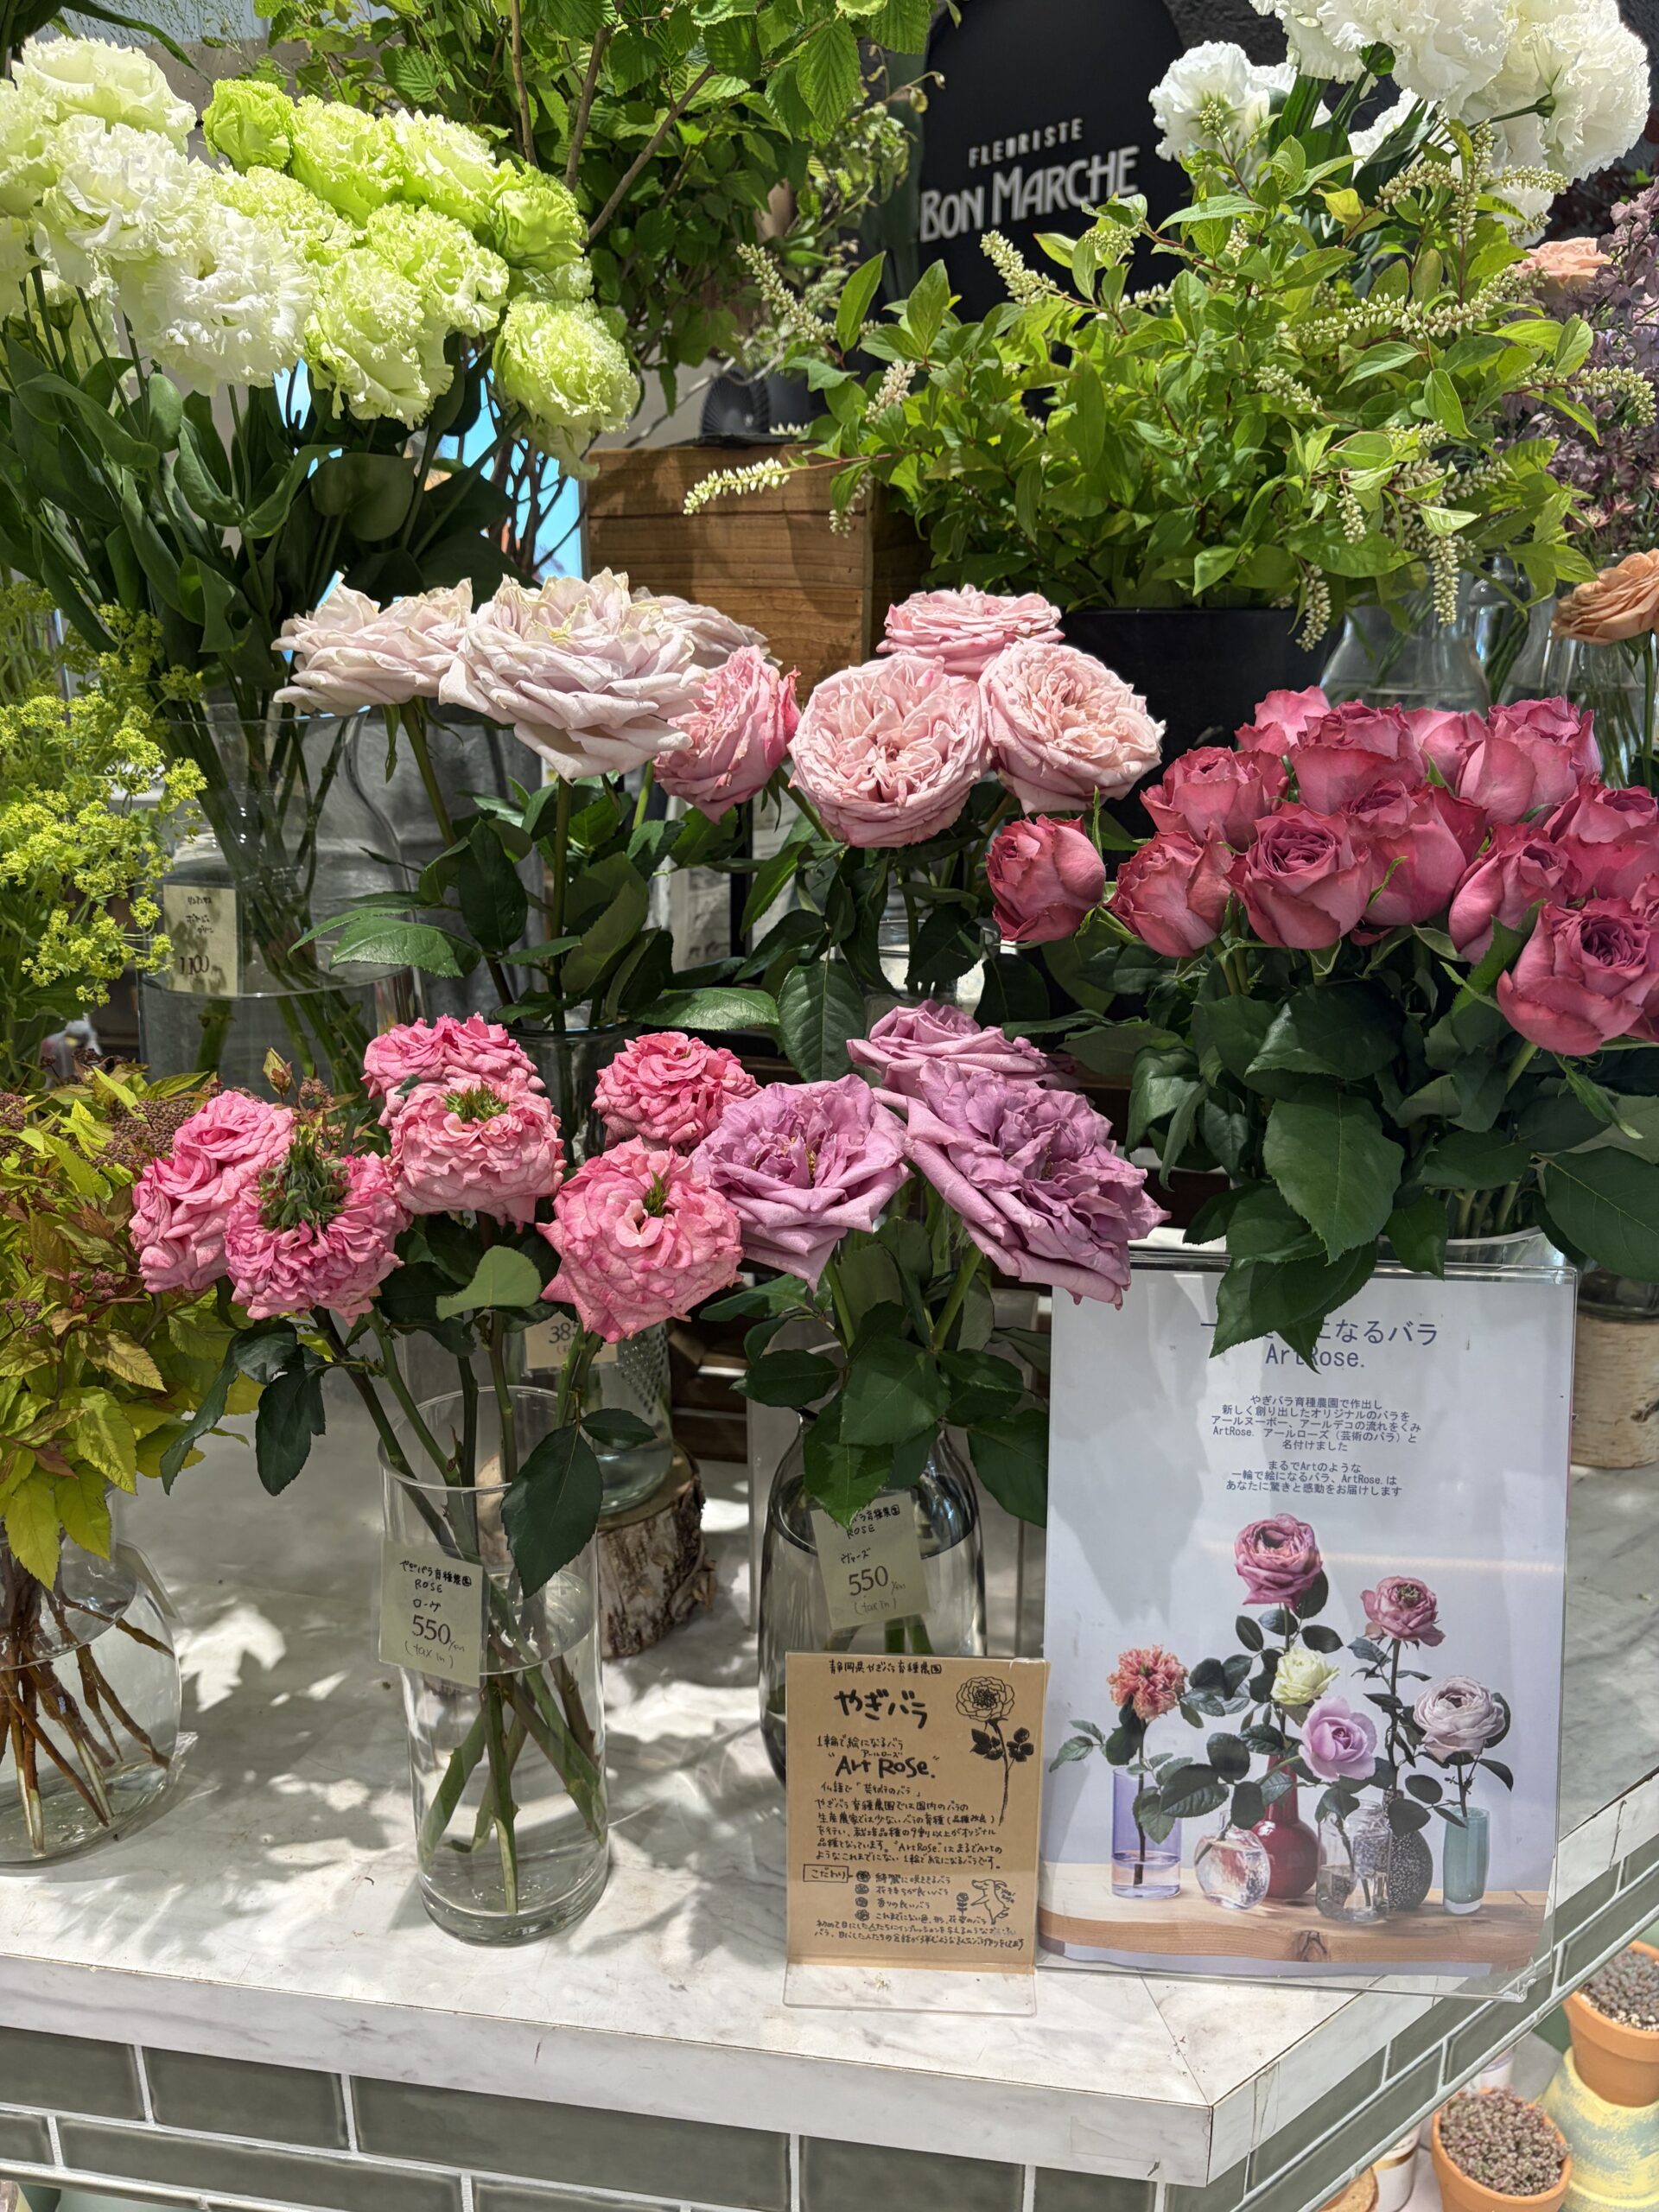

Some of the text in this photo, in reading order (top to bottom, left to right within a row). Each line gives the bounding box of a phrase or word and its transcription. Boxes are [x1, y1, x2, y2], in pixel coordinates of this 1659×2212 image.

[969, 118, 1083, 168] FLEURISTE
[920, 145, 1140, 243] BON MARCHE
[1251, 1395, 1382, 1410] やぎバラ育種農園で作出し
[1222, 1404, 1410, 1422] 新しく創り出したオリジナルのバラを
[1211, 1415, 1421, 1433] アールヌーボー、アールデコの流れをくみ
[1282, 1439, 1348, 1452] 名付けました
[1268, 1460, 1361, 1474] まるでArtのような
[1226, 1479, 1402, 1497] あなたに驚きと感動をお届けします
[847, 1524, 875, 1539] ROSE
[415, 1579, 442, 1593] ROSE
[849, 1566, 888, 1596] 550
[411, 1614, 451, 1645] 550
[834, 1688, 928, 1729] やぎバラ
[810, 1866, 847, 1880] こだわり
